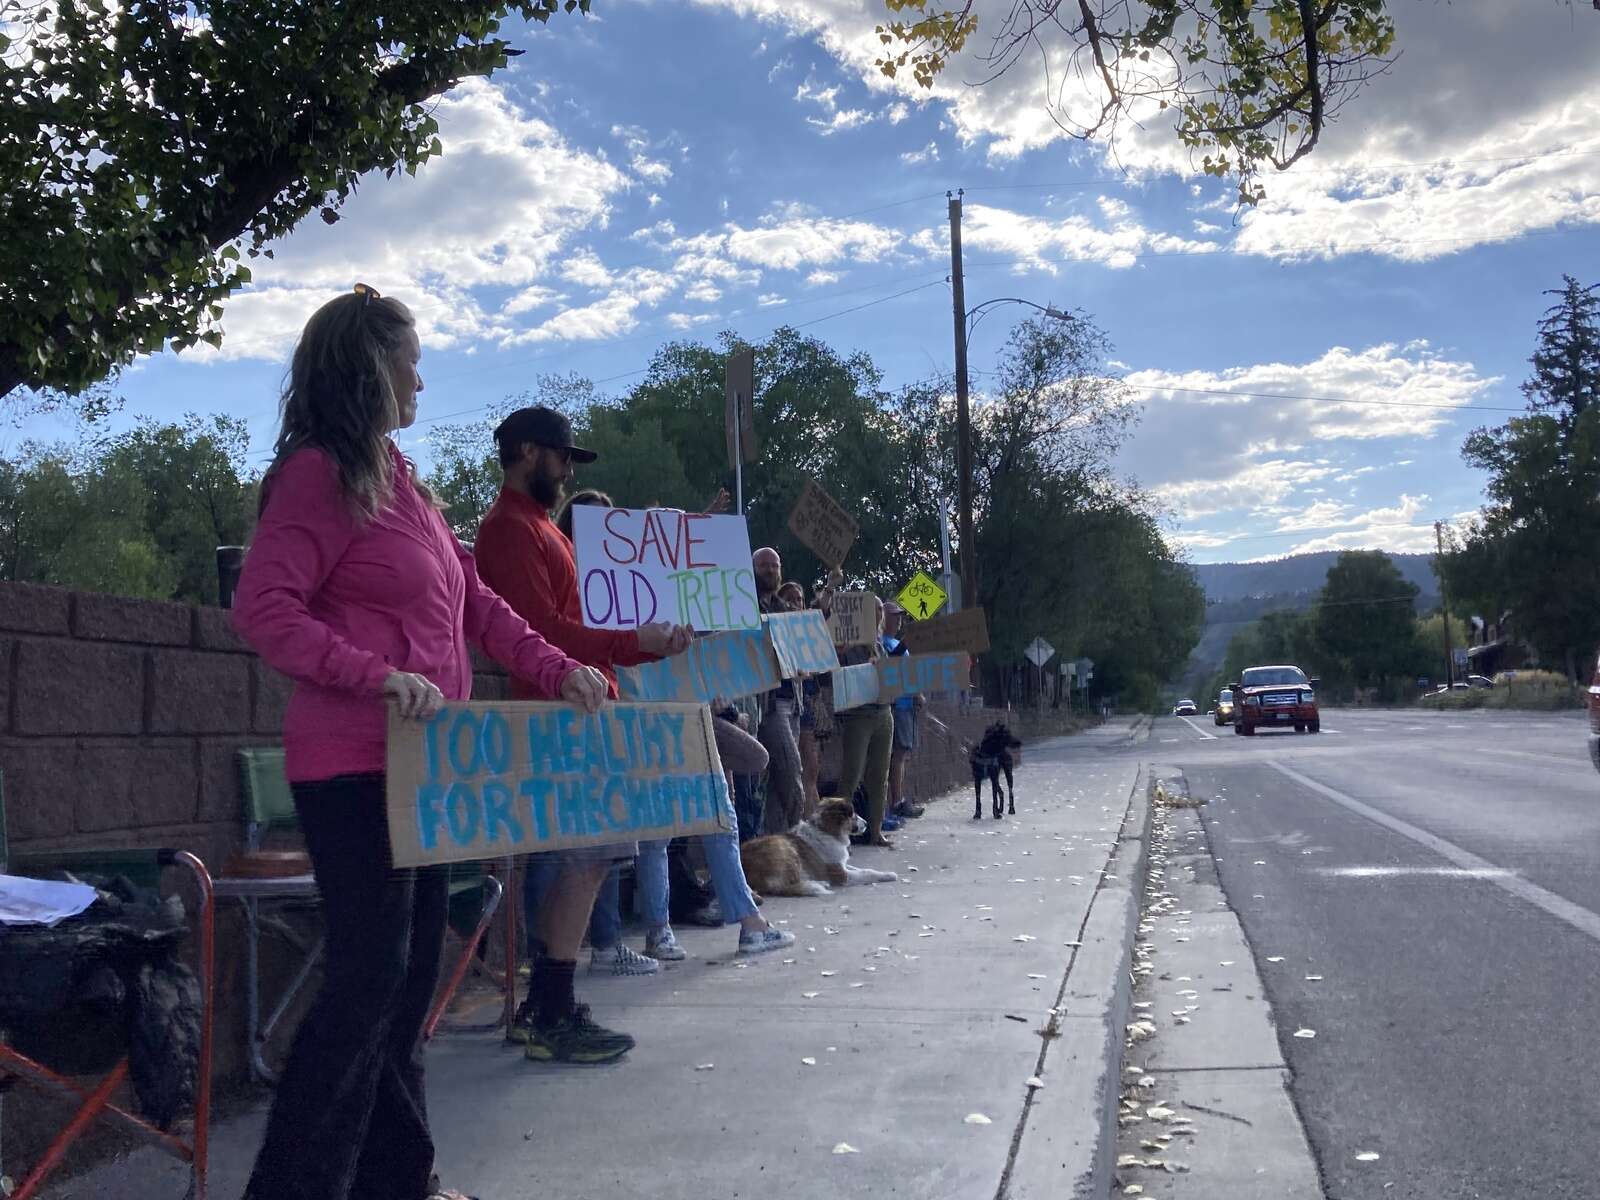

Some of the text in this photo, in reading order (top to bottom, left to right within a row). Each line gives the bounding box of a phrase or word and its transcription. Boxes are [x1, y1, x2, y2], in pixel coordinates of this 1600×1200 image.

[603, 509, 717, 570] SAVE
[584, 568, 760, 630] OLD TREES
[423, 706, 685, 782] TOO HEALTHY
[416, 781, 525, 851] FOR
